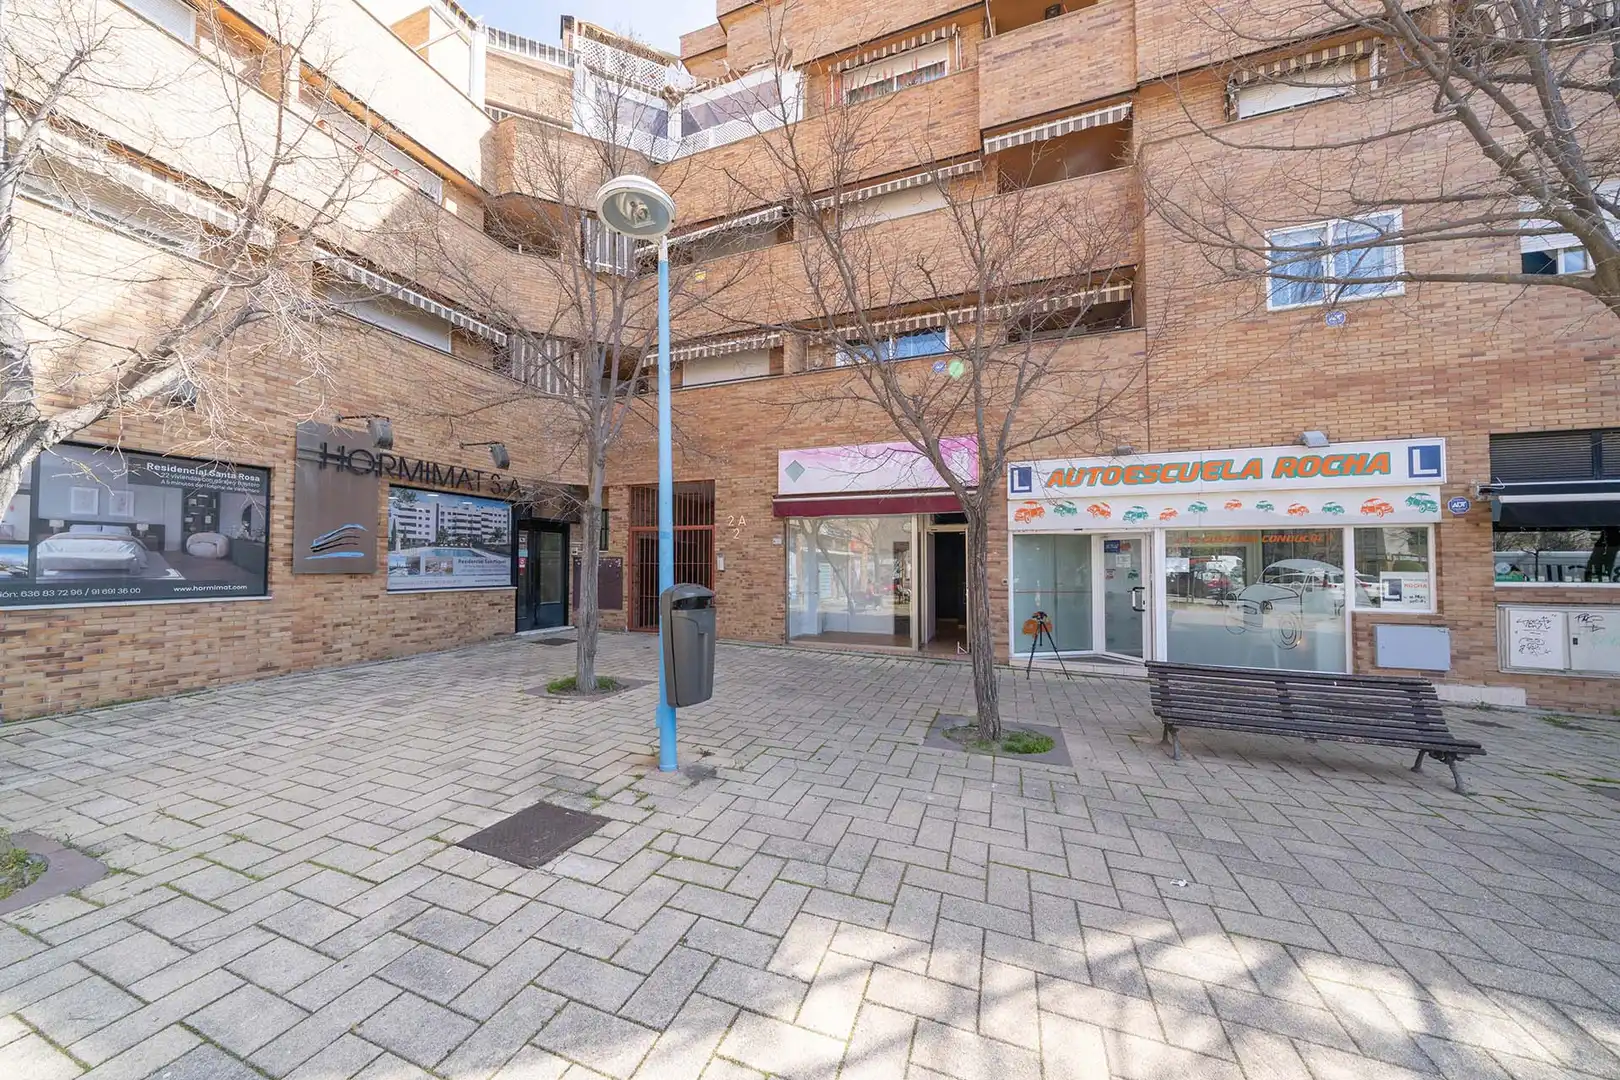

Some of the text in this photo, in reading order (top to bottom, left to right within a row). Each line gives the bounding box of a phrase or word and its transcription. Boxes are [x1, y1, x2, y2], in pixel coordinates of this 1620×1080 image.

[146, 462, 260, 482] Residencial Santa Rosa
[319, 442, 484, 492] HORMIMAT
[1047, 451, 1391, 488] AUTOESCUELA ROCHA
[733, 528, 740, 540] 2
[20, 589, 40, 597] 636
[42, 589, 55, 597] 83
[173, 584, 248, 592] www.hormimat.com
